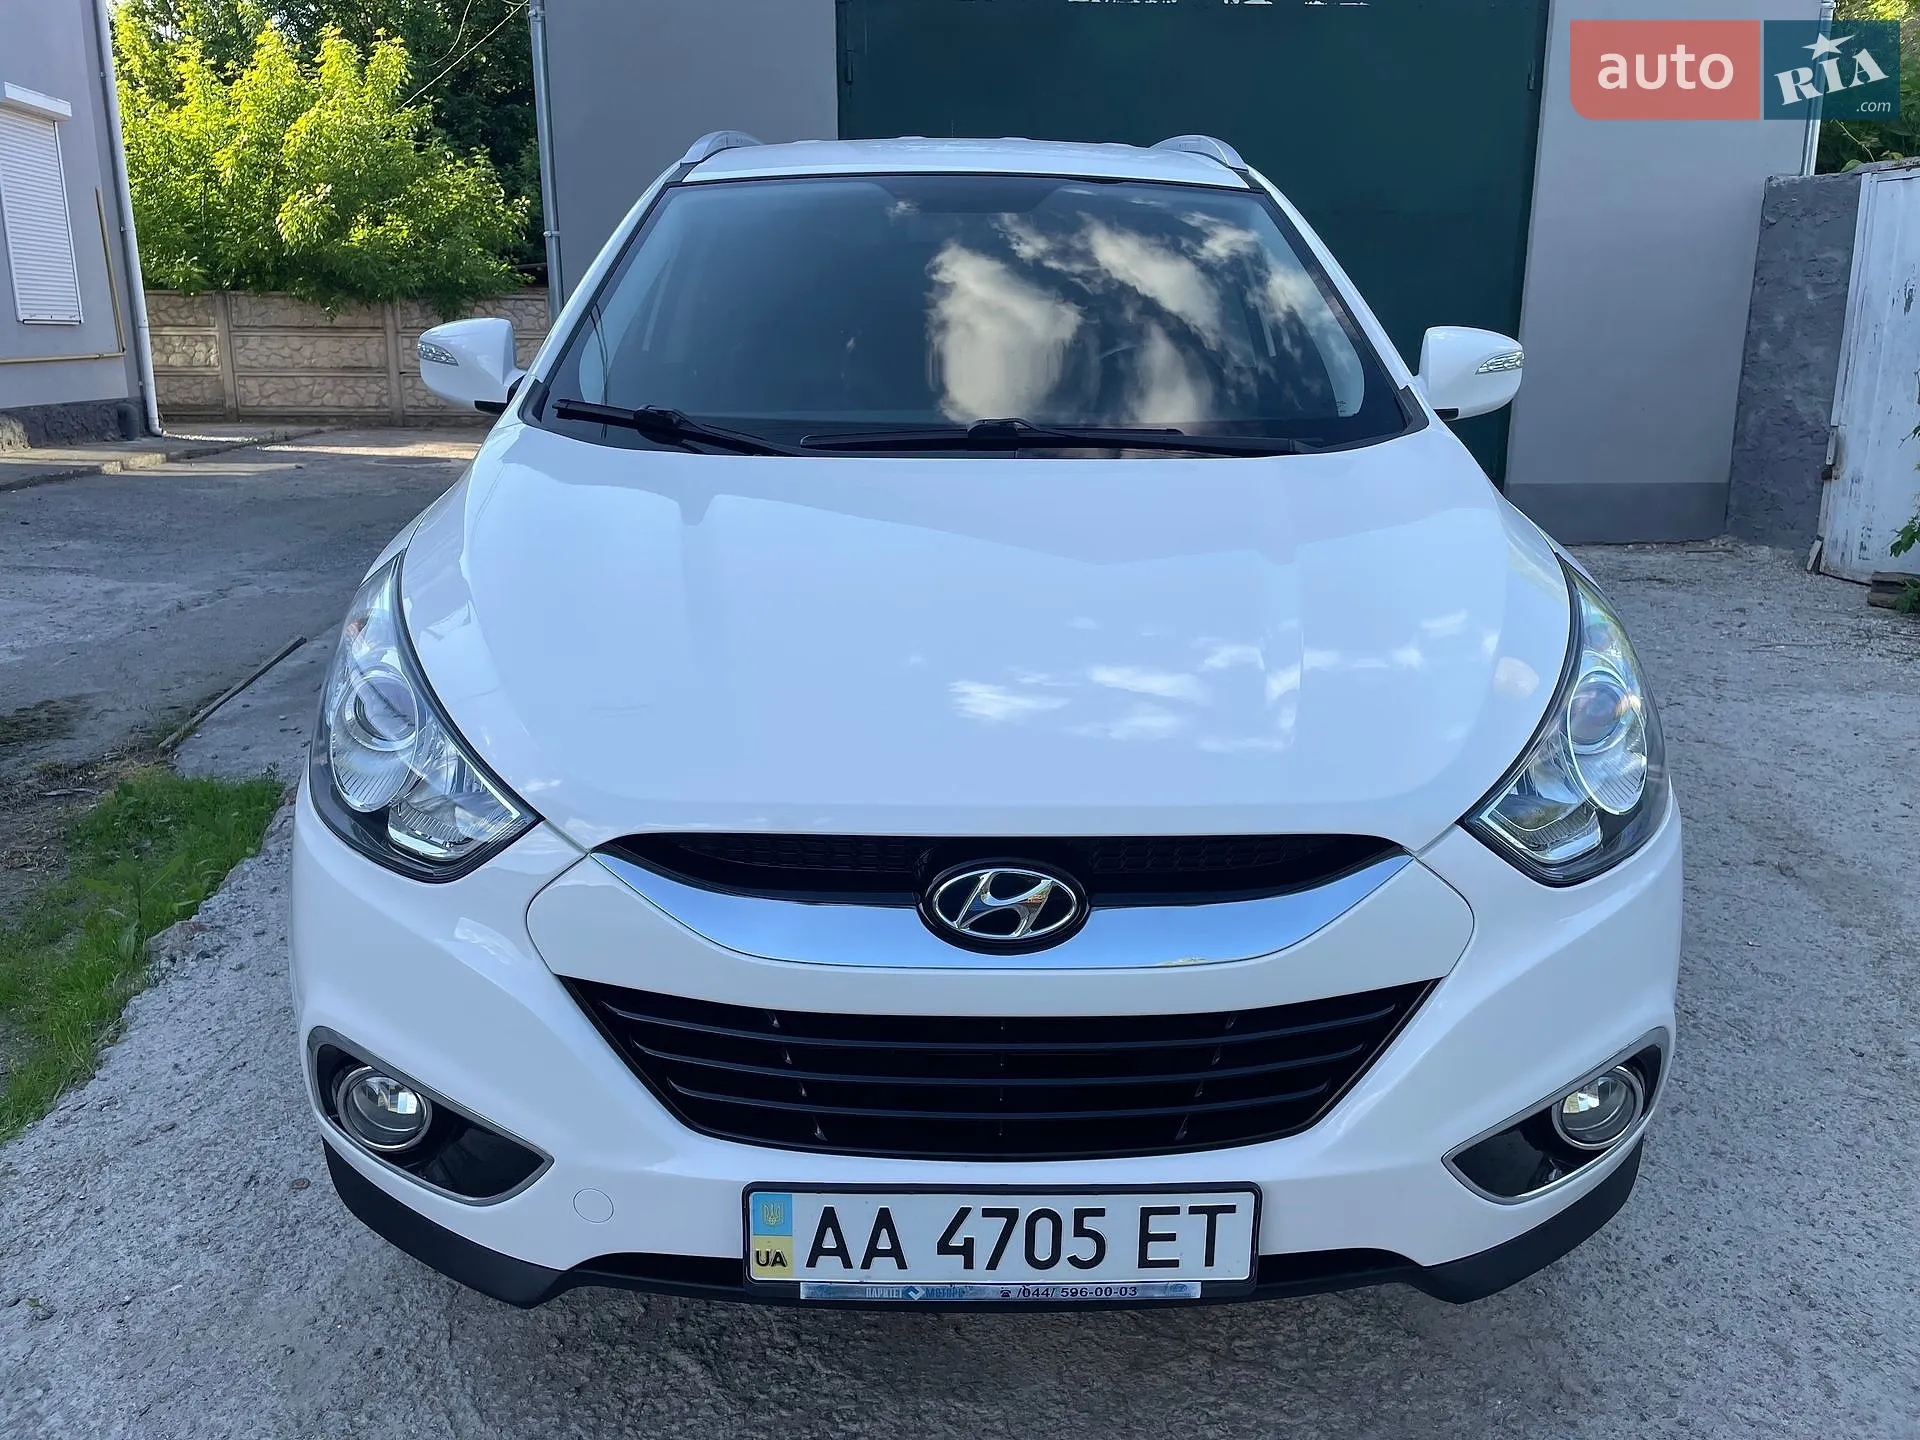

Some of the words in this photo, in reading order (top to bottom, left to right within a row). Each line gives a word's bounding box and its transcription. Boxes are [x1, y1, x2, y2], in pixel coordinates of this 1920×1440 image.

[805, 1206, 908, 1270] AA
[936, 1206, 1106, 1270] 4705
[1137, 1205, 1237, 1268] ET
[755, 1249, 788, 1268] UA
[1060, 1286, 1138, 1298] 596-00-03
